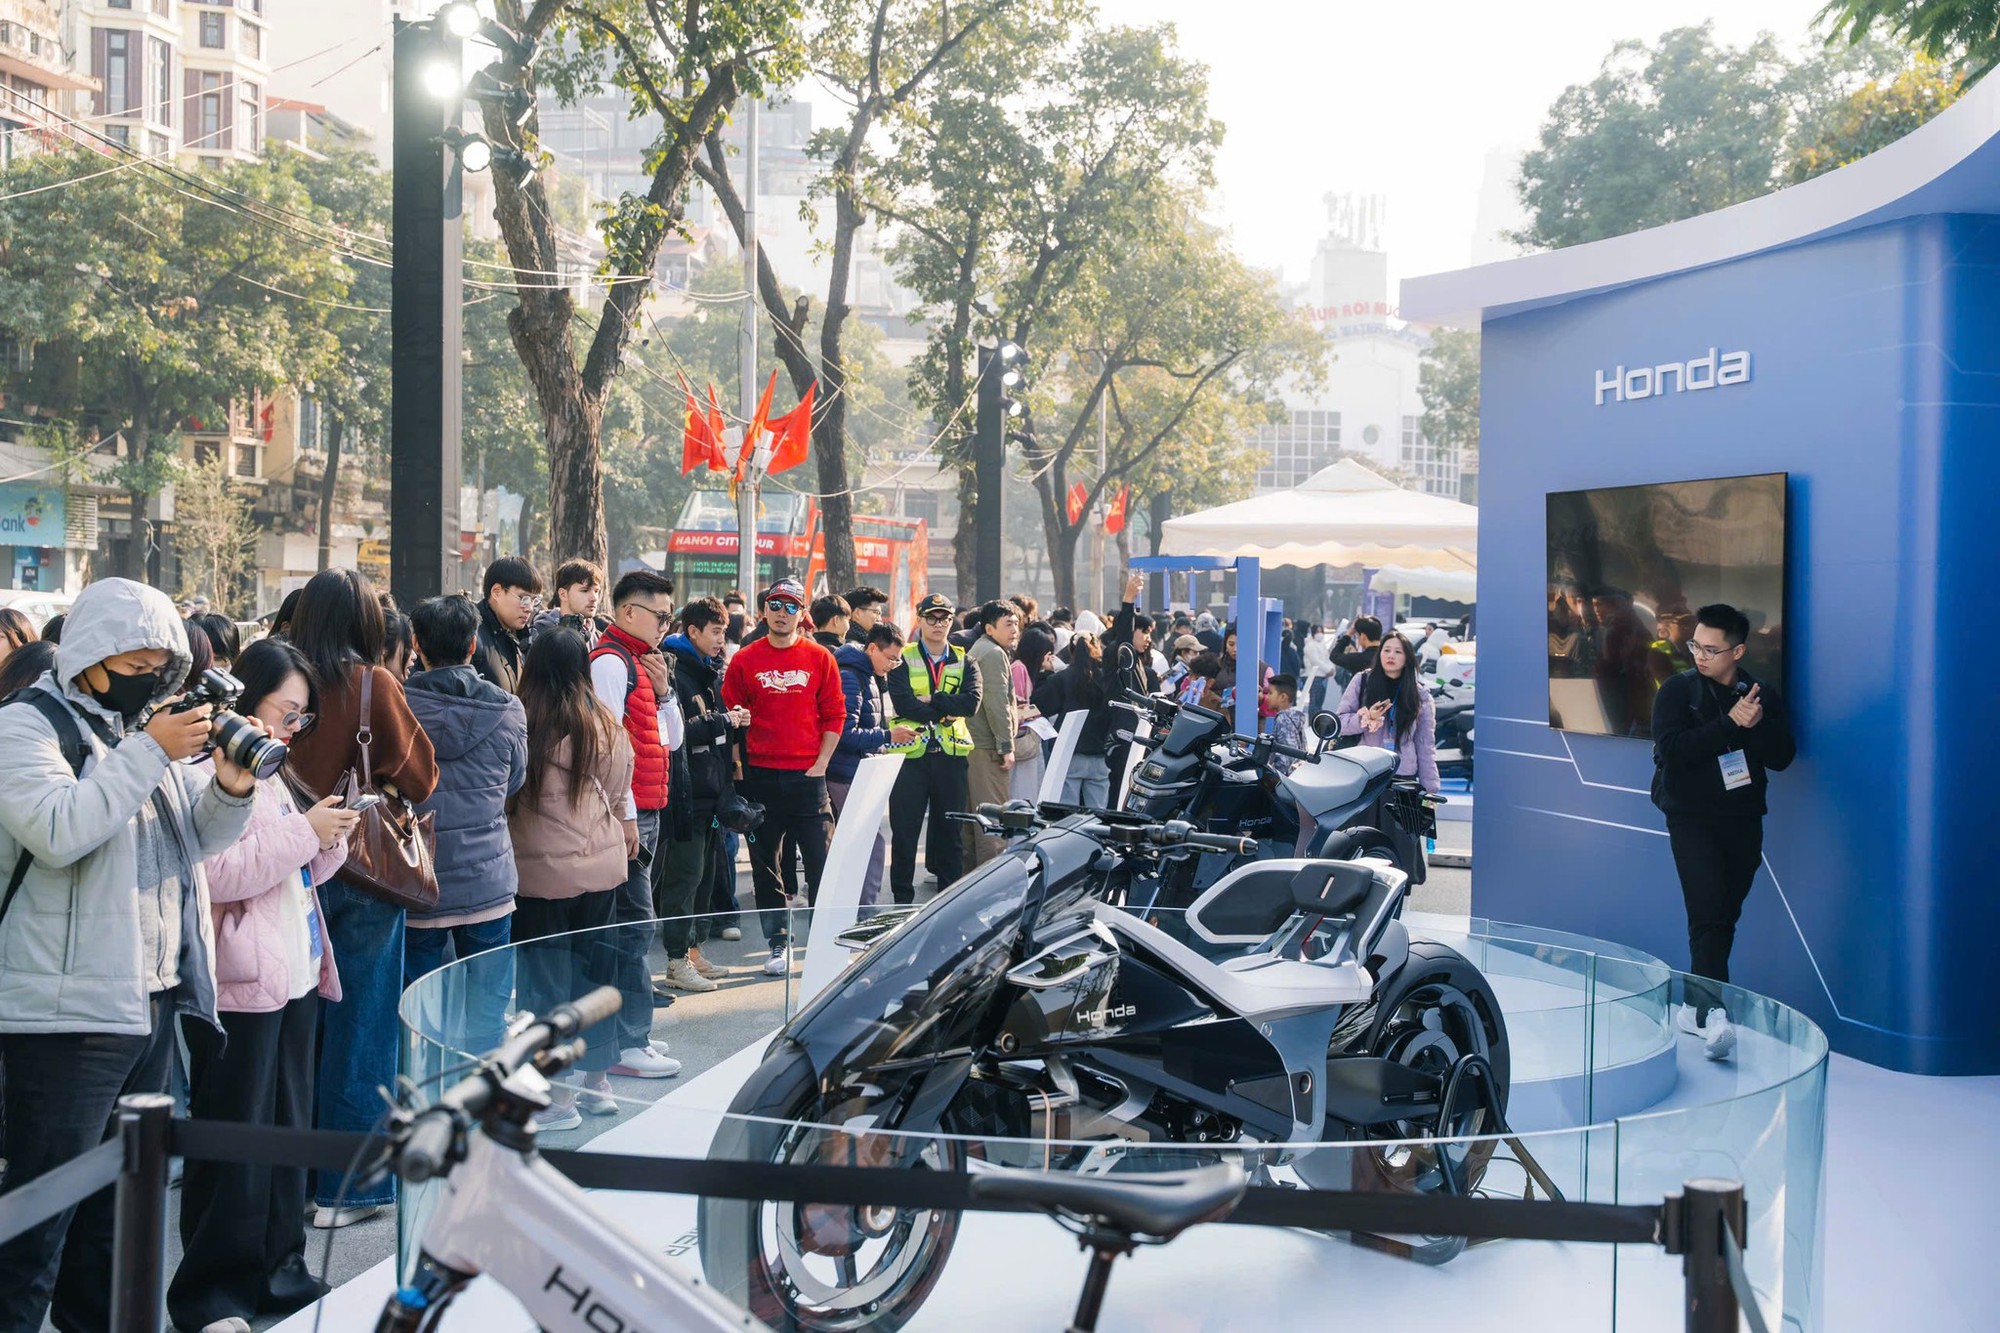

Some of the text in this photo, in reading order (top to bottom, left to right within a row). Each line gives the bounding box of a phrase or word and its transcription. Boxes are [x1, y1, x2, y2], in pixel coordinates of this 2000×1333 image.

[1595, 347, 1751, 405] Honda
[0, 513, 26, 532] ank
[675, 536, 714, 547] HANOI
[1727, 769, 1744, 777] MEDIA
[1239, 816, 1272, 827] Honda
[1076, 1004, 1137, 1023] Honda
[543, 1264, 638, 1333] Ho
